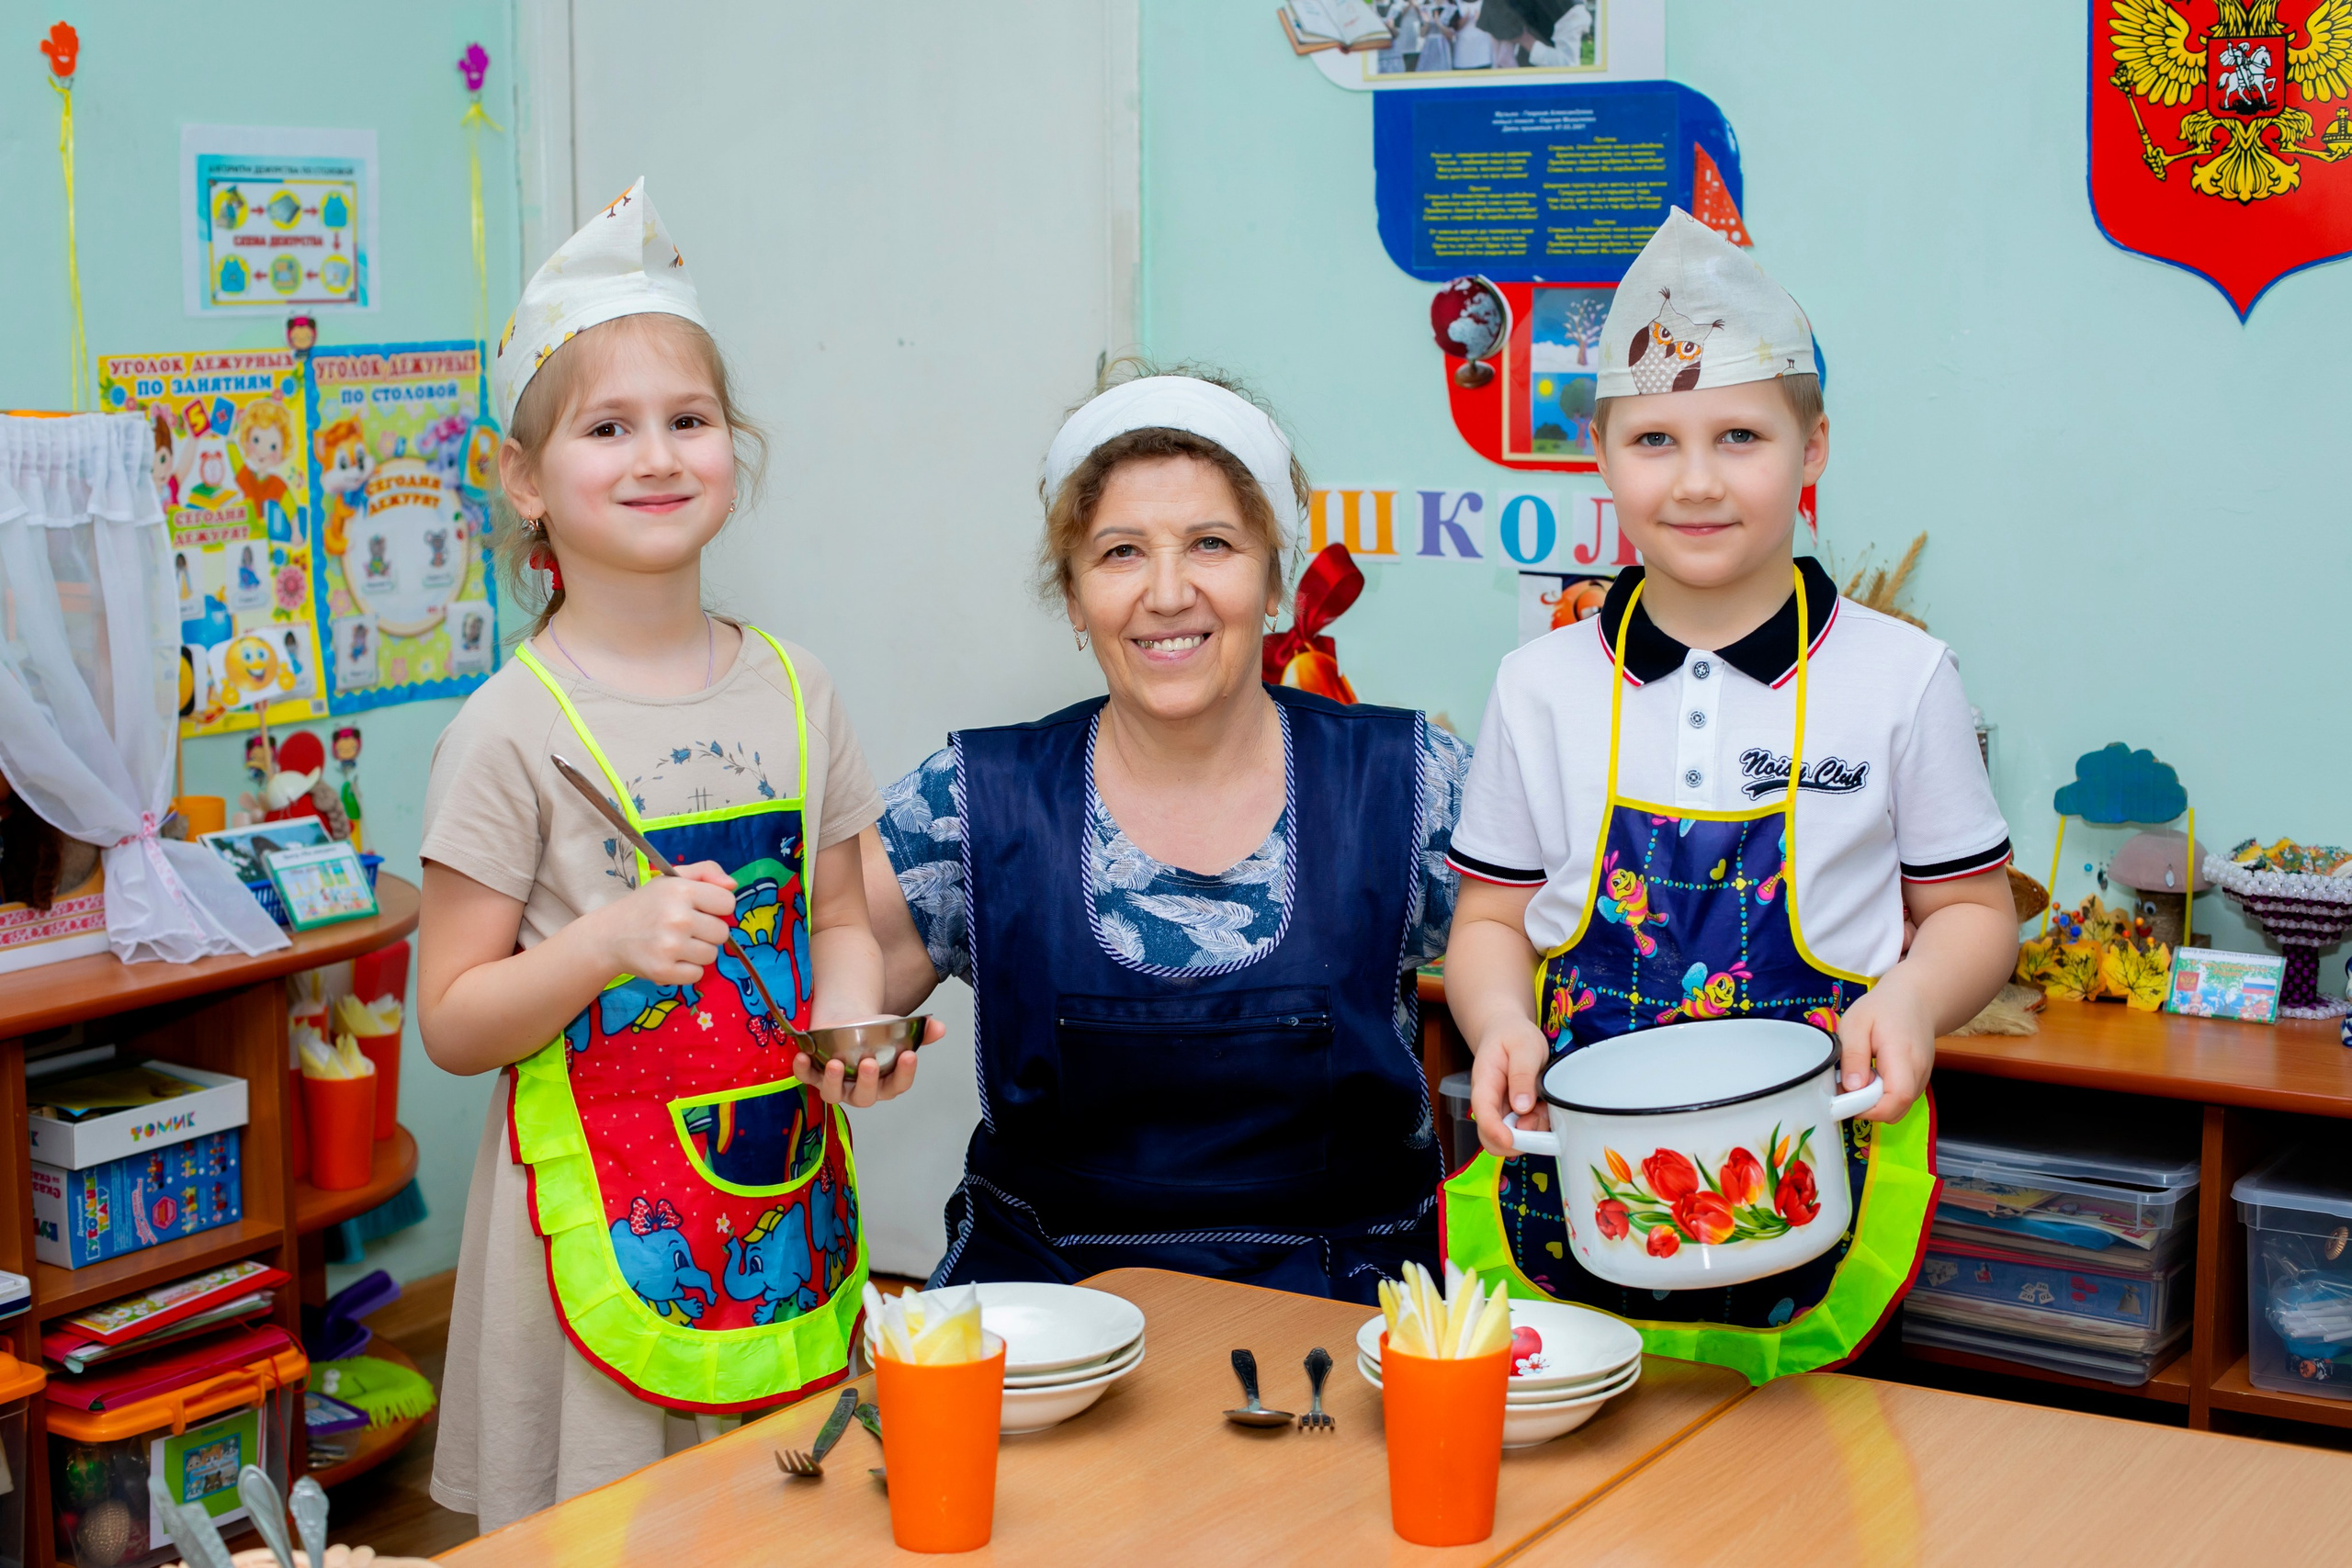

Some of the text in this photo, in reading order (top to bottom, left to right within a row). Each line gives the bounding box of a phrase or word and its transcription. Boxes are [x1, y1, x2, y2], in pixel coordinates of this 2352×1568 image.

[109, 357, 184, 376] УГОЛОК
[316, 359, 381, 379] УГОЛОК
[137, 375, 273, 396] ПО ЗАНЯТИЯМ
[341, 382, 458, 404] ПО СТОЛОВОЙ
[365, 474, 441, 497] СЕГОДНЯ
[368, 492, 441, 516] ДЕЖУРЯТ
[174, 506, 246, 526] СЕГОДНЯ
[174, 526, 251, 547] ДЕЖУРЯТ
[1306, 490, 1643, 566] ШКОЛ
[1815, 759, 1868, 785] Club
[130, 1110, 197, 1143] ТОМИК
[96, 1187, 110, 1233] ТЕАТР
